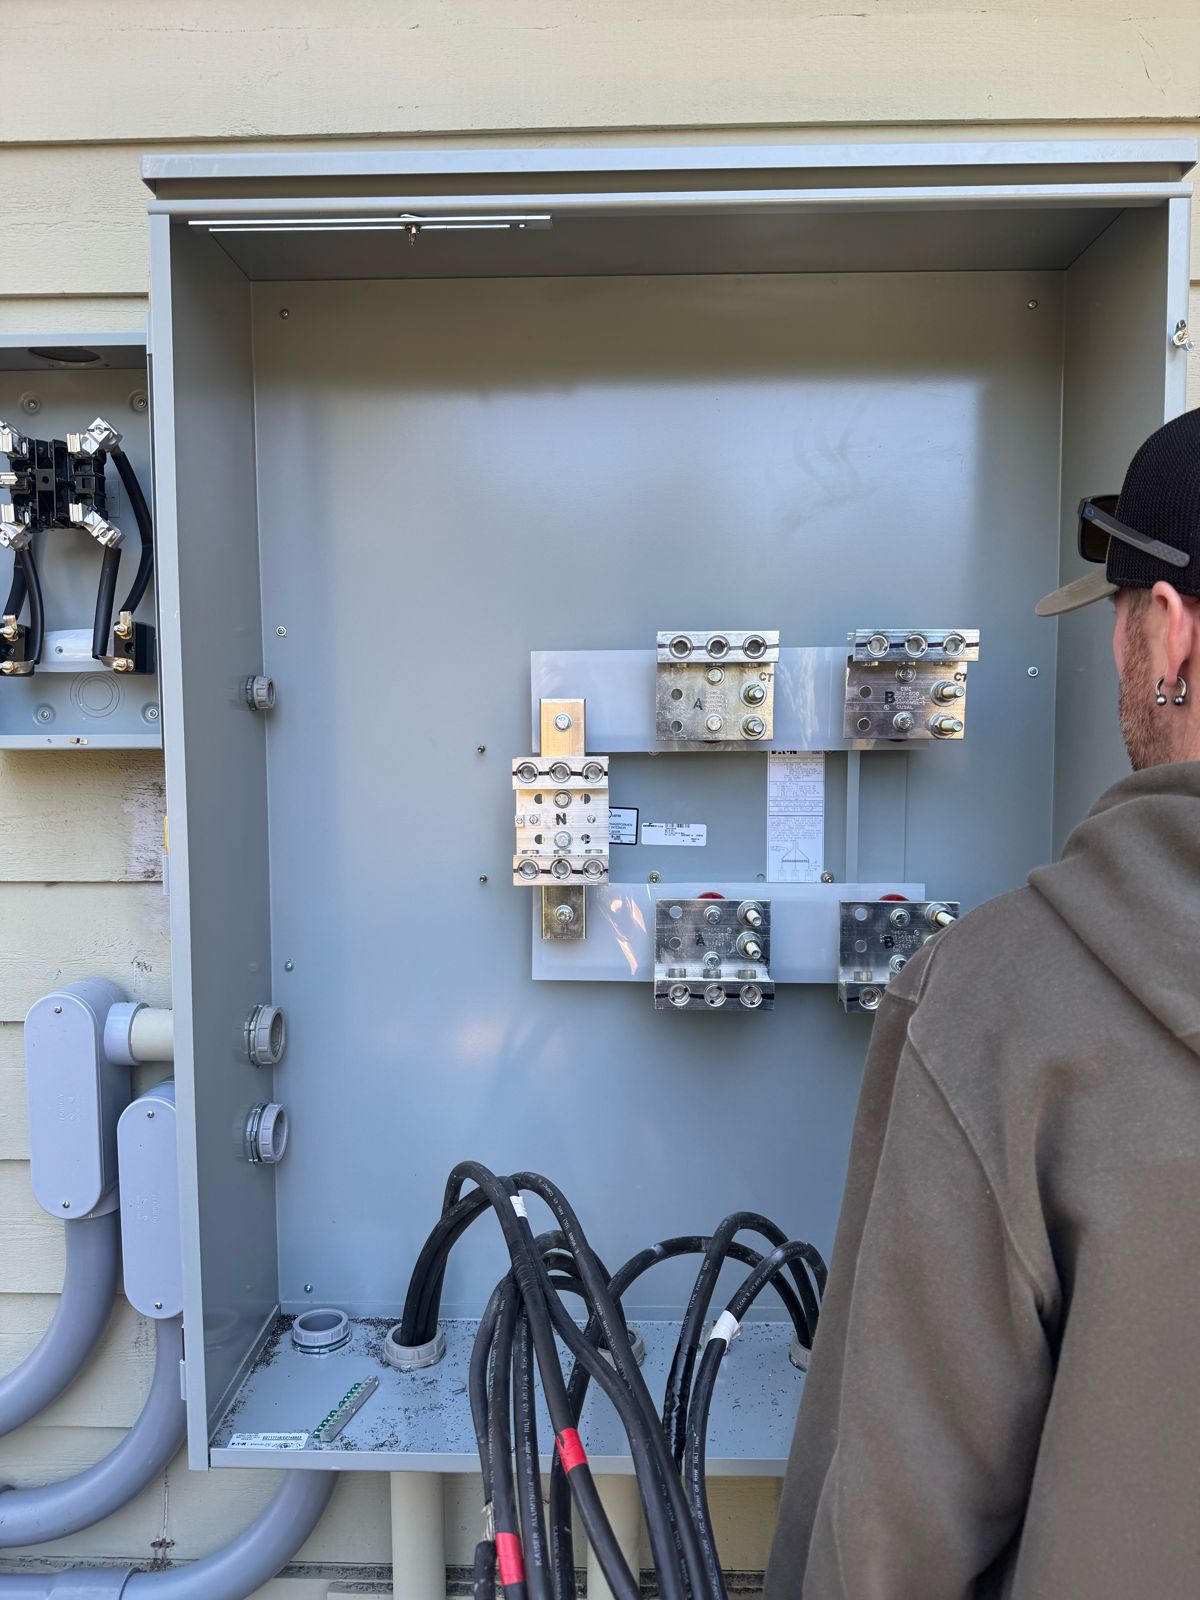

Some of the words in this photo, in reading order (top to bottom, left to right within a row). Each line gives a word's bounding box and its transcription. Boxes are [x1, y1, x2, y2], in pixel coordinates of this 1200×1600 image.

[759, 672, 774, 682] CT
[693, 698, 703, 710] A
[884, 691, 896, 704] B
[555, 812, 567, 825] N
[695, 933, 705, 946] A
[883, 935, 895, 949] B
[531, 1532, 542, 1566] KAISER
